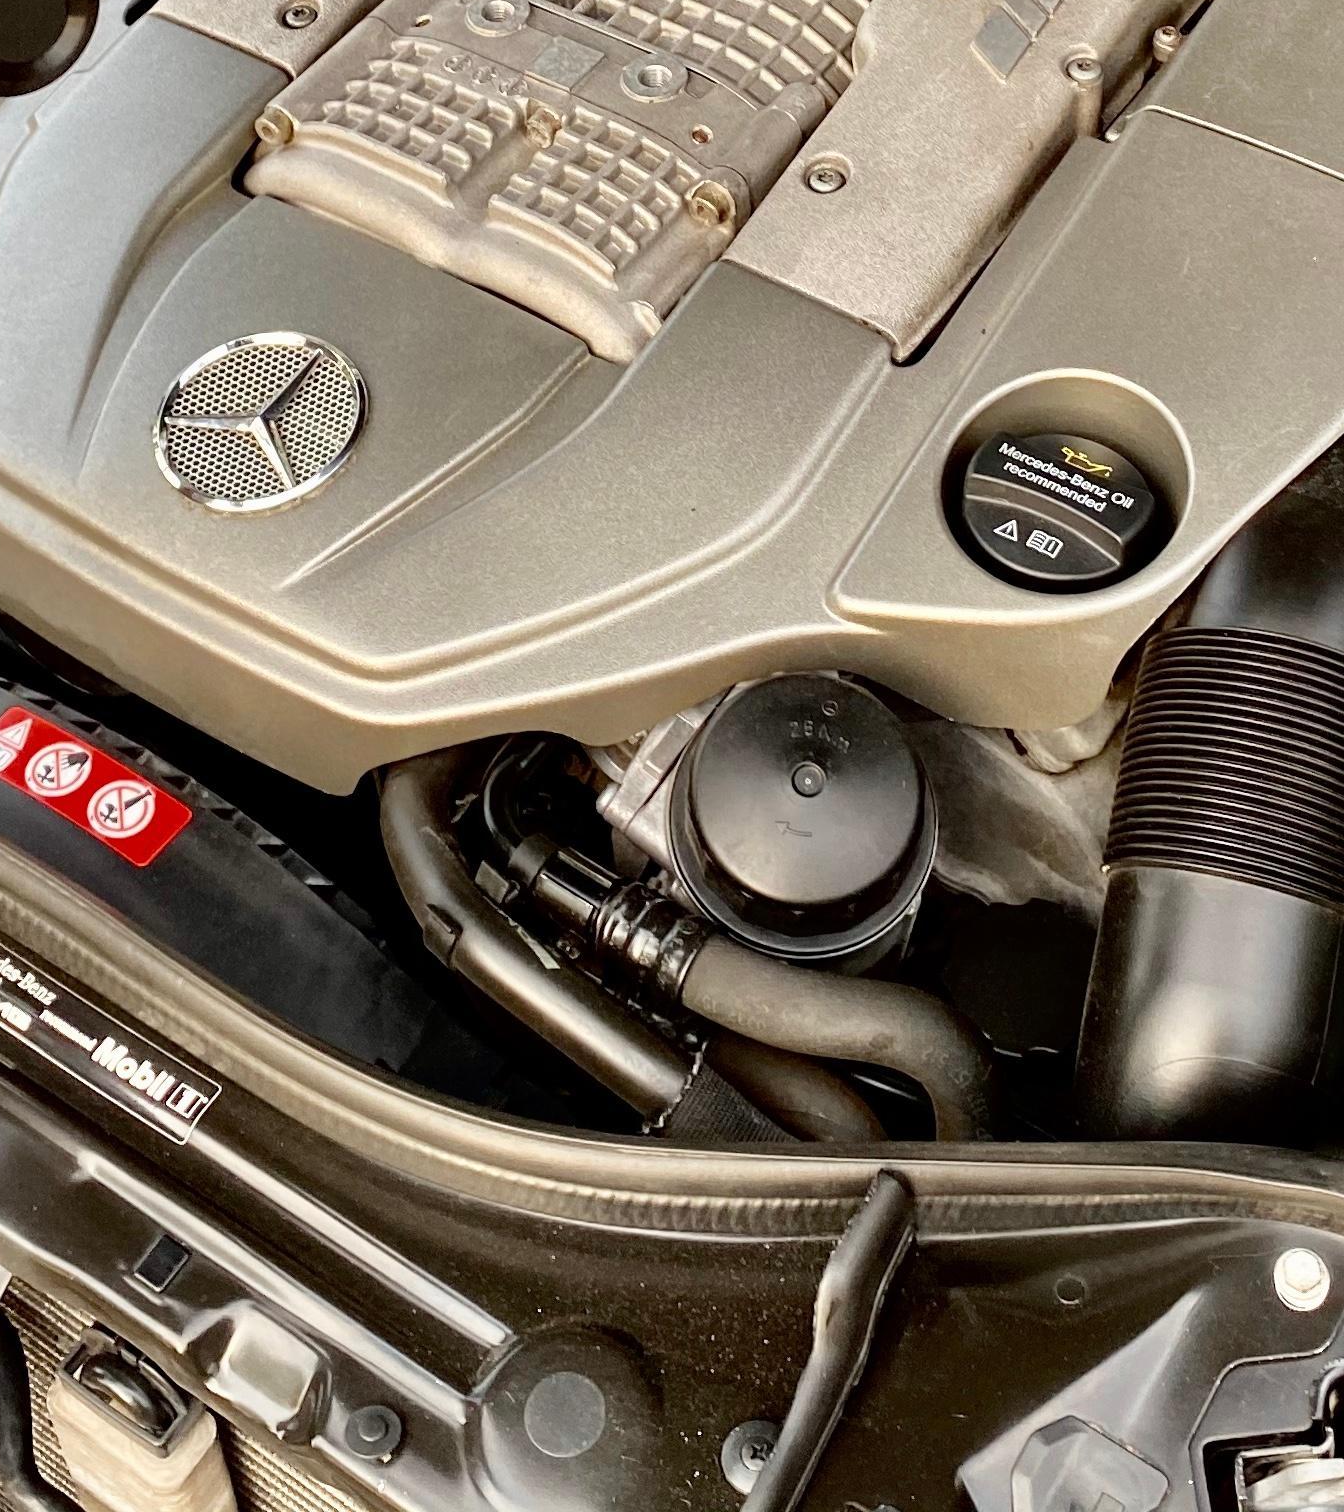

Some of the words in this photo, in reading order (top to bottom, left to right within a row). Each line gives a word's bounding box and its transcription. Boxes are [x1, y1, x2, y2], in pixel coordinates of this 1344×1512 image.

[998, 442, 1109, 498] Mercedes-Benz
[1111, 491, 1135, 509] Oil
[1003, 460, 1108, 513] recommended
[91, 1036, 176, 1101] Mobil
